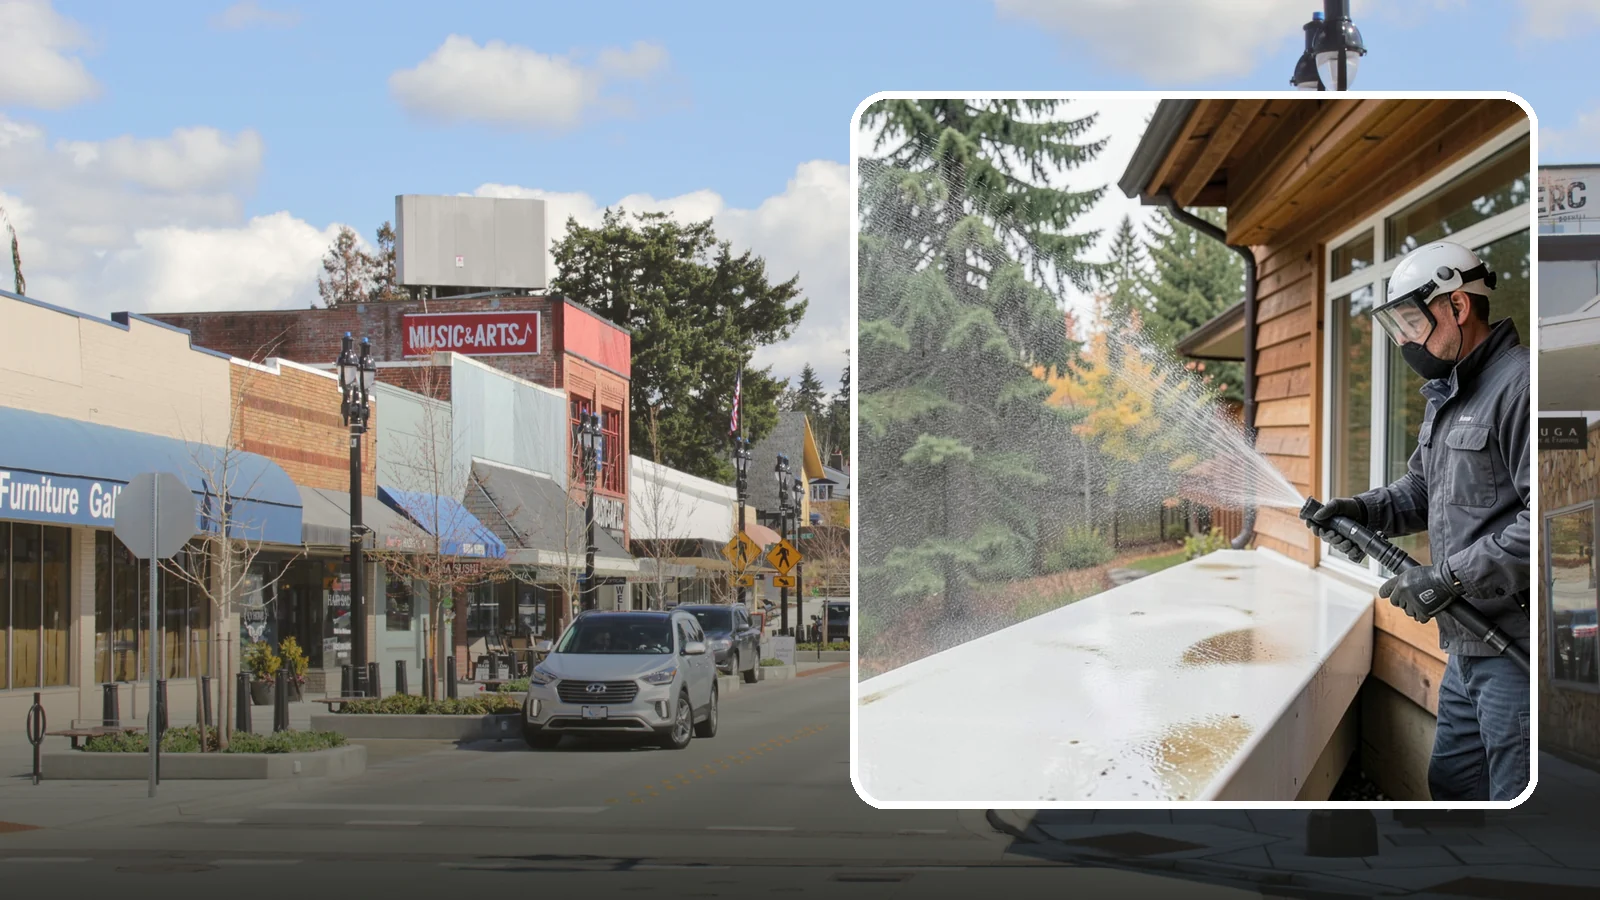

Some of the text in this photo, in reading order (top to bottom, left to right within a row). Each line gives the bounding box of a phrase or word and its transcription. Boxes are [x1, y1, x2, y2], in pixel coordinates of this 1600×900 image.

[0, 472, 121, 519] Furniture Gal
[453, 563, 479, 575] SUSHI
